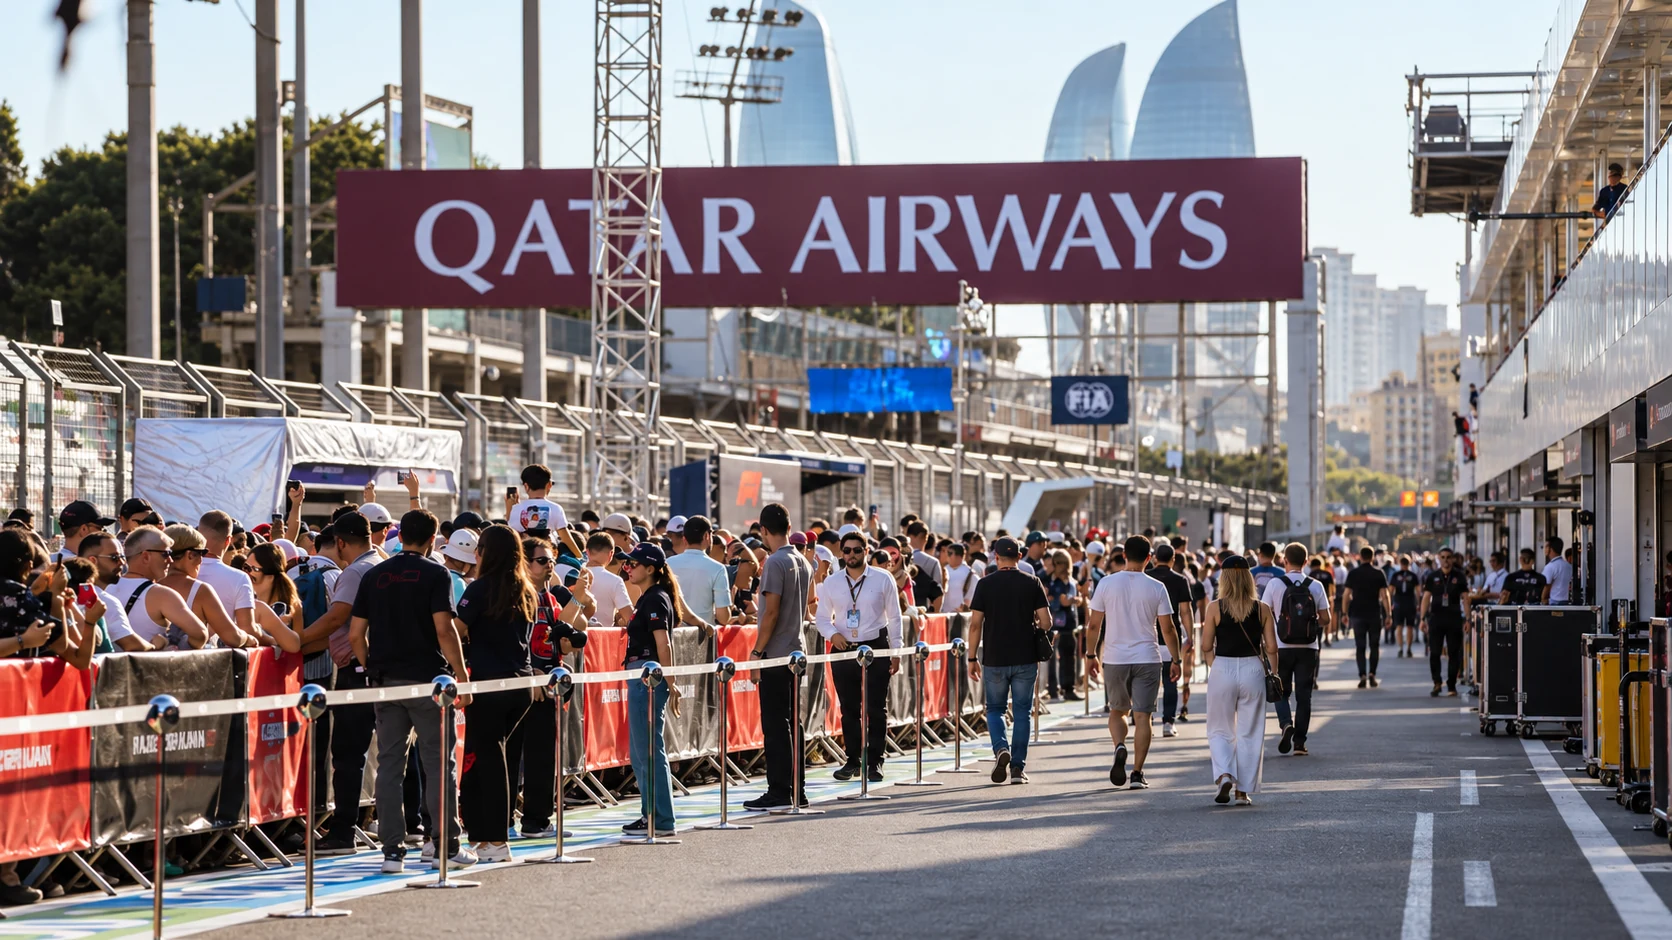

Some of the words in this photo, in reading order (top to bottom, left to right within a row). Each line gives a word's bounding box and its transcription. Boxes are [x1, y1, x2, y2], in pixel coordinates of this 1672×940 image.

[414, 198, 762, 294] QATAR
[789, 190, 1228, 273] AIRWAYS
[1068, 388, 1110, 411] FIA
